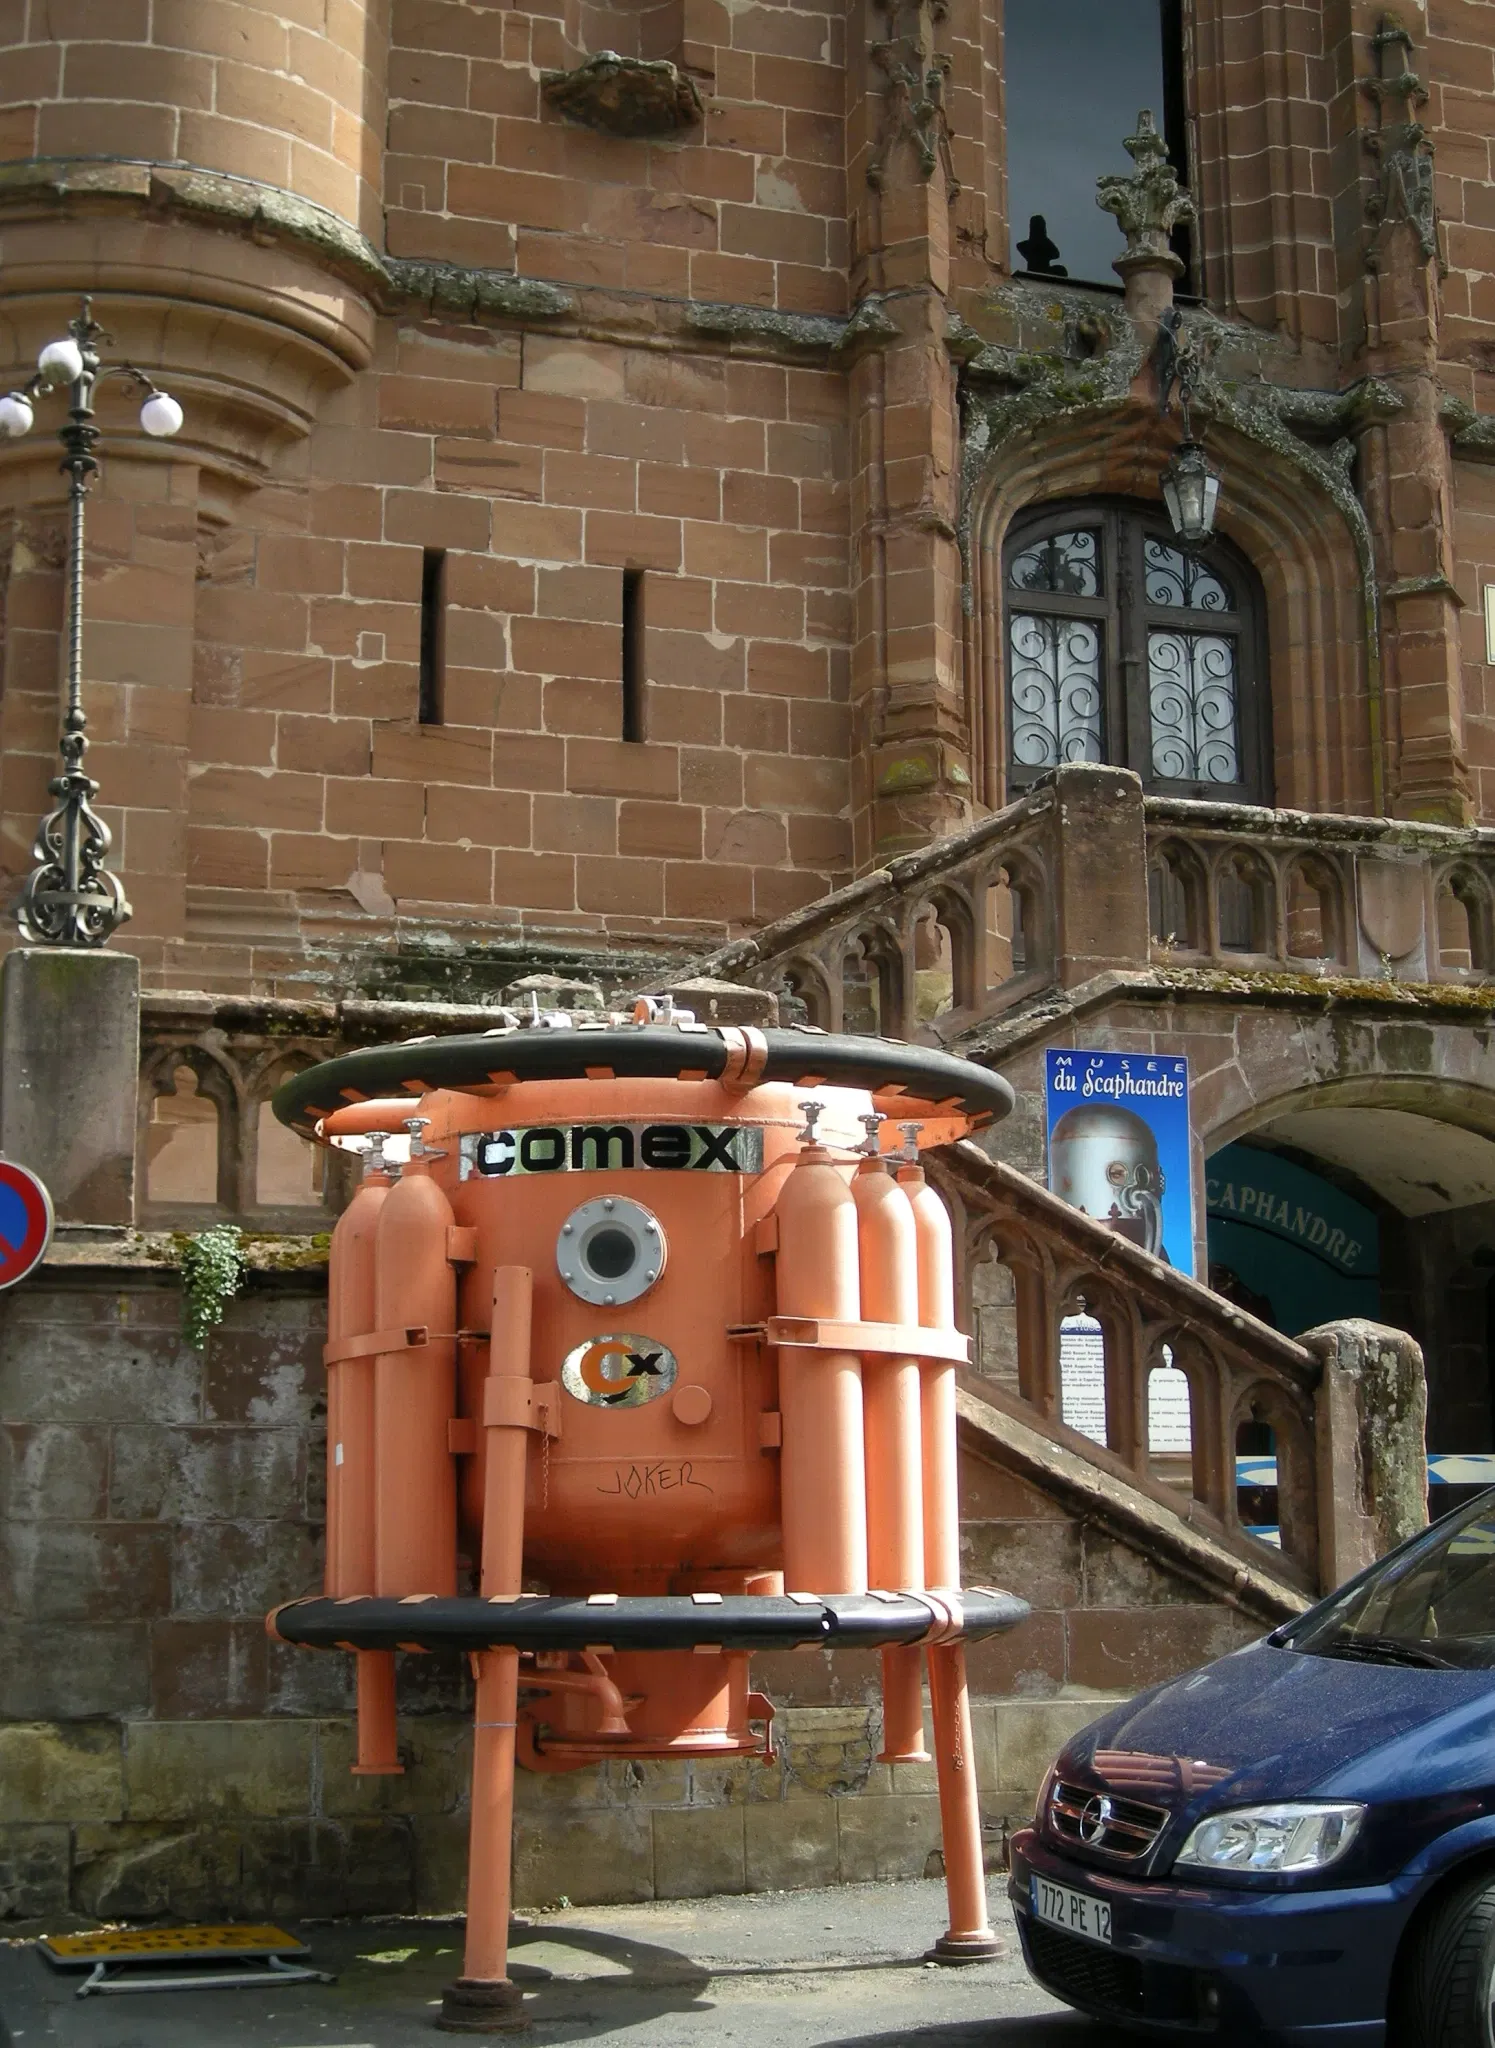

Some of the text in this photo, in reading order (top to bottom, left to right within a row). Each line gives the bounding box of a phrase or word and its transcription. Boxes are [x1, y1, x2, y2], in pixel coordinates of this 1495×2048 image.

[1054, 1068, 1184, 1099] du Scaphandre
[1055, 1056, 1185, 1073] MUSEE
[477, 1125, 742, 1175] comex
[596, 1461, 714, 1500] JOKER
[1041, 1883, 1111, 1940] 772 PE 12
